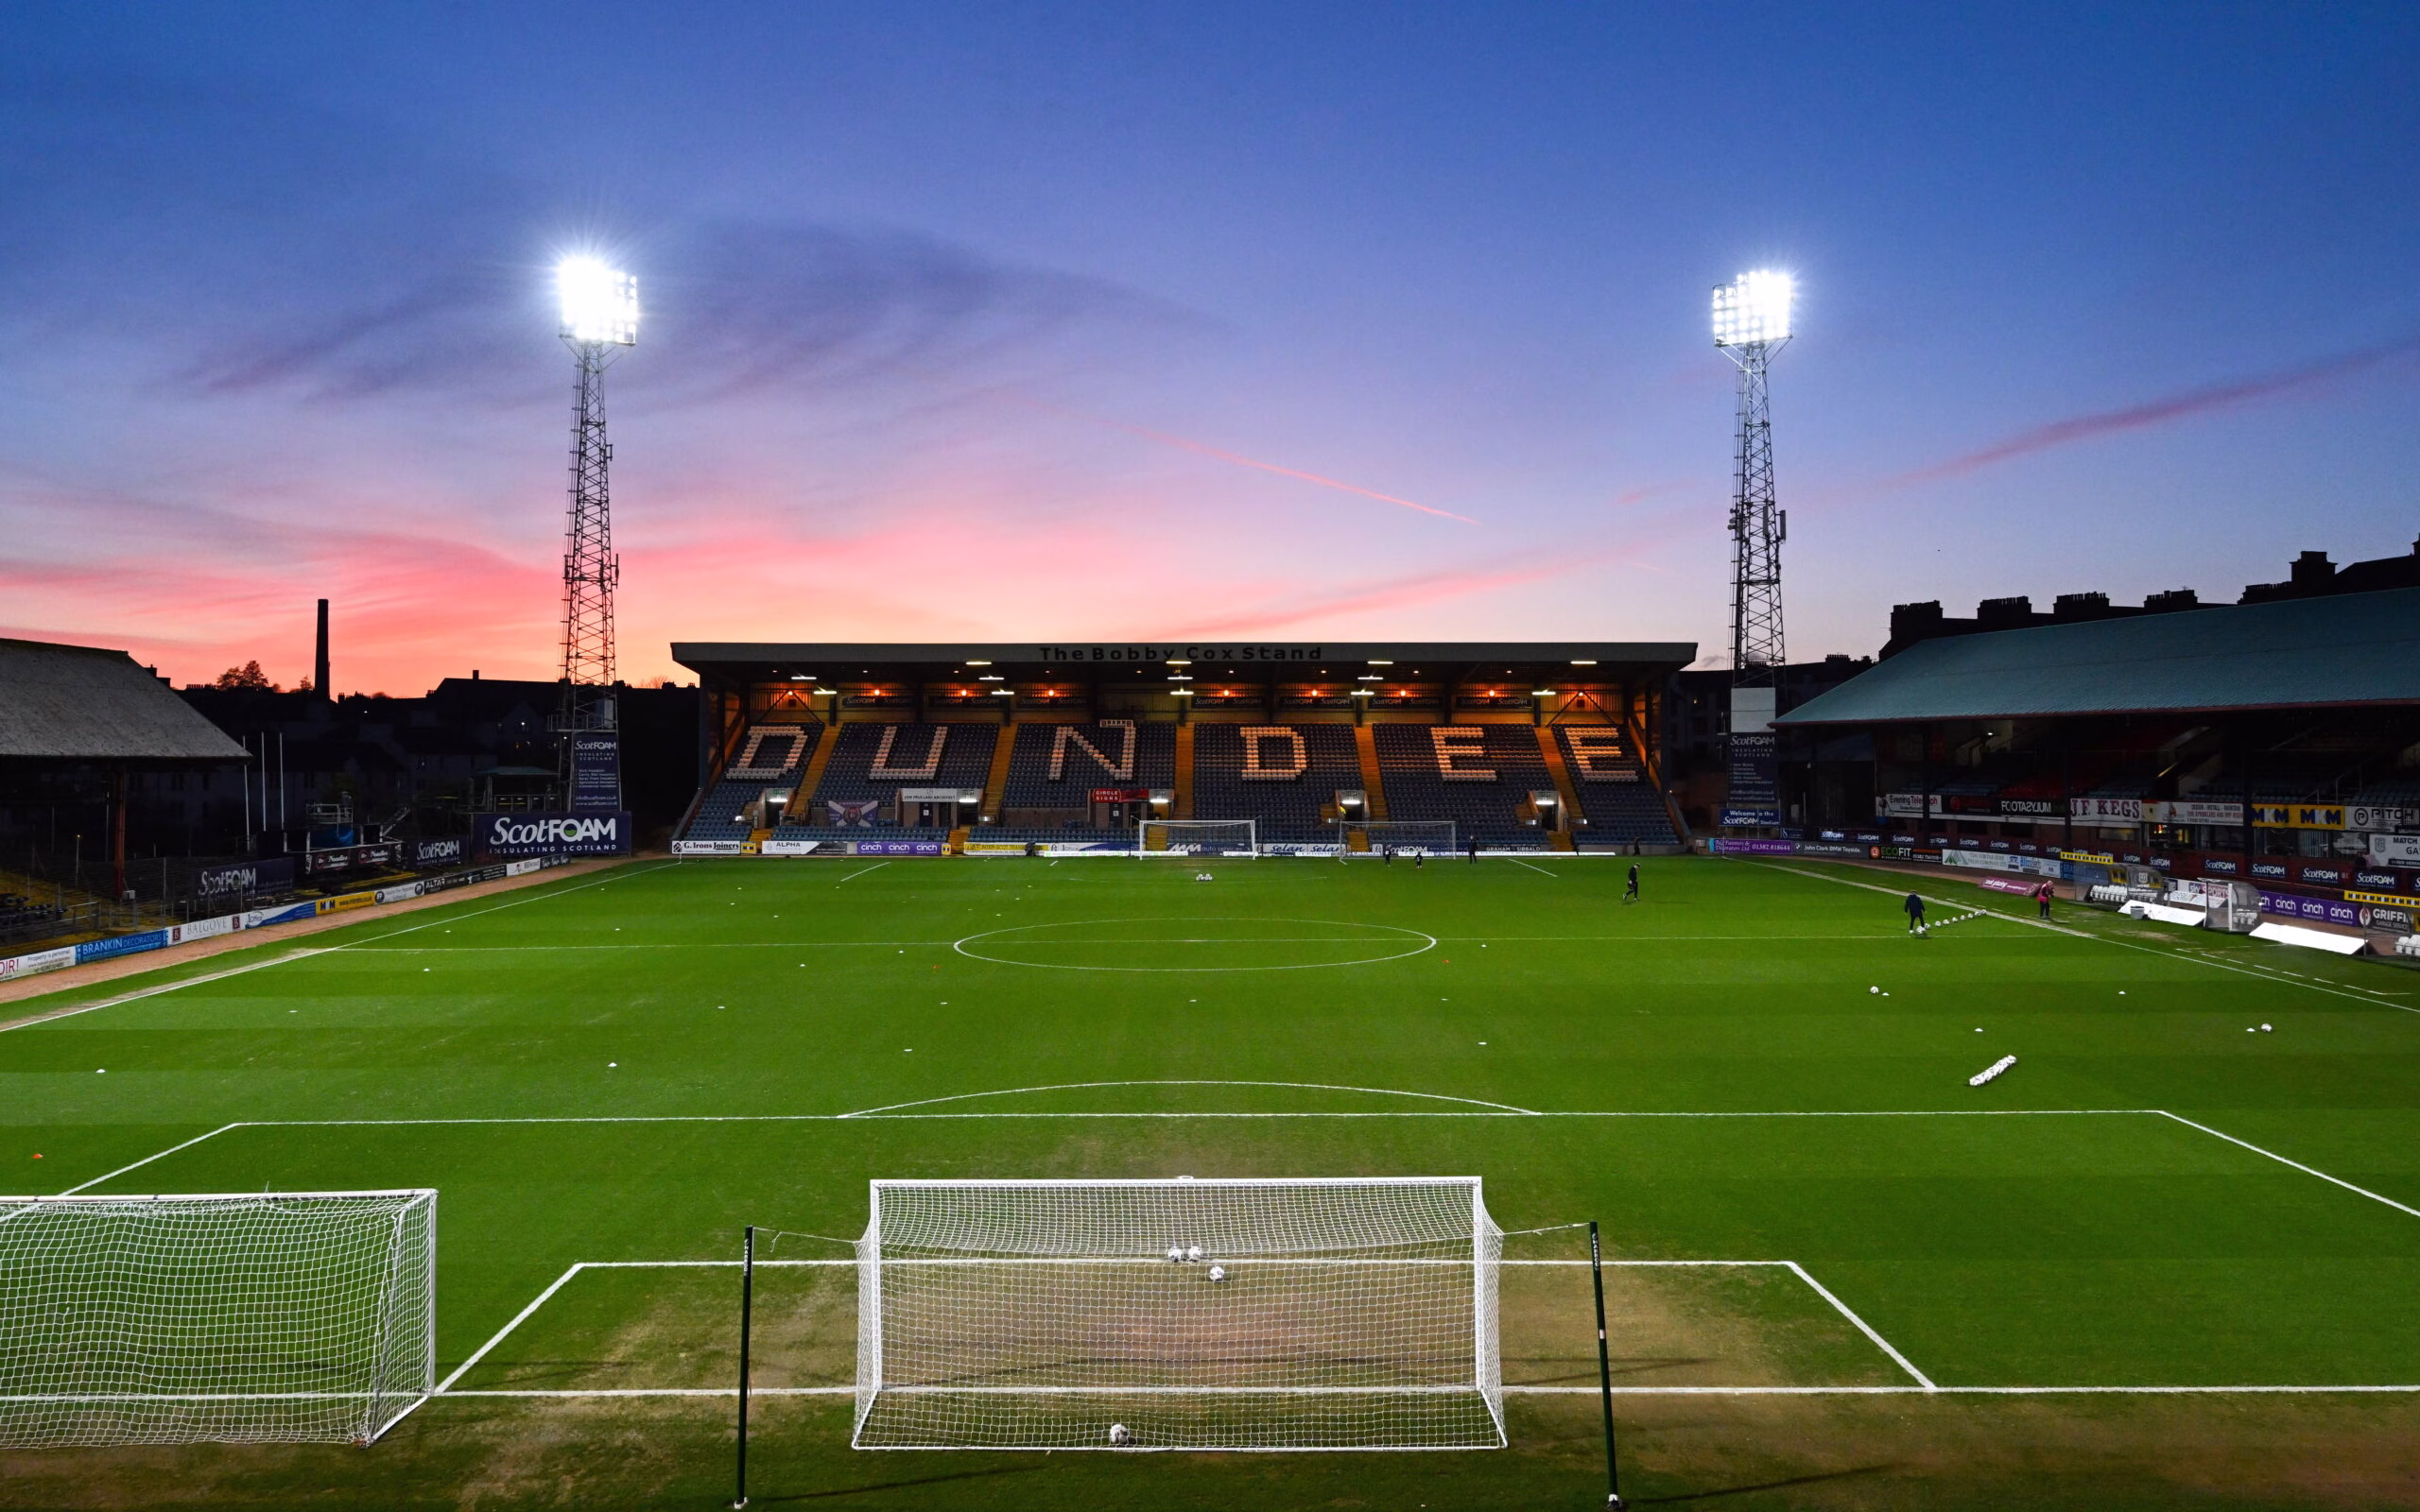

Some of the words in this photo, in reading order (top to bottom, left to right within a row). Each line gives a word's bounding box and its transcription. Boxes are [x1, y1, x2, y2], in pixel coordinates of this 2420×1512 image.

[1039, 647, 1084, 661] The
[1092, 647, 1175, 662] Bobby
[1185, 646, 1234, 660] Cox
[1242, 646, 1322, 660] Stand
[574, 741, 617, 750] ScotFOAM
[1730, 735, 1775, 746] ScotFOAM
[1890, 795, 1910, 805] Evening
[2097, 800, 2140, 819] KEGS
[2253, 807, 2290, 823] MKM
[2371, 808, 2413, 819] PITCH
[1722, 816, 1758, 825] ScotFOAM
[2300, 808, 2342, 824] MKM
[490, 817, 616, 845] ScotFOAM
[1892, 834, 1915, 843] ScotFOAM
[1959, 837, 1980, 847] ScotFOAM
[1989, 839, 2010, 849] ScotFOAM
[416, 839, 460, 861] ScotFOAM
[563, 844, 616, 852] SCOTLAND
[861, 843, 882, 851] cinch
[889, 843, 909, 851] cinch
[916, 843, 938, 851] cinch
[1270, 844, 1305, 852] selan
[1881, 846, 1912, 856] ECOFIT
[2018, 843, 2038, 851] ScotFOAM
[2149, 856, 2170, 867] ScotFOAM
[2205, 859, 2237, 870] ScotFOAM
[2252, 864, 2286, 875] ScotFOAM
[2303, 868, 2339, 880] ScotFOAM
[2357, 872, 2395, 885] ScotFOAM
[2189, 883, 2201, 894] sky
[2275, 896, 2296, 911] cinch
[2302, 900, 2324, 915] cinch
[2330, 904, 2353, 919] cinch
[187, 916, 228, 935] BALGOVE
[82, 938, 123, 955] BRANKIN
[123, 933, 163, 947] DECORATORS
